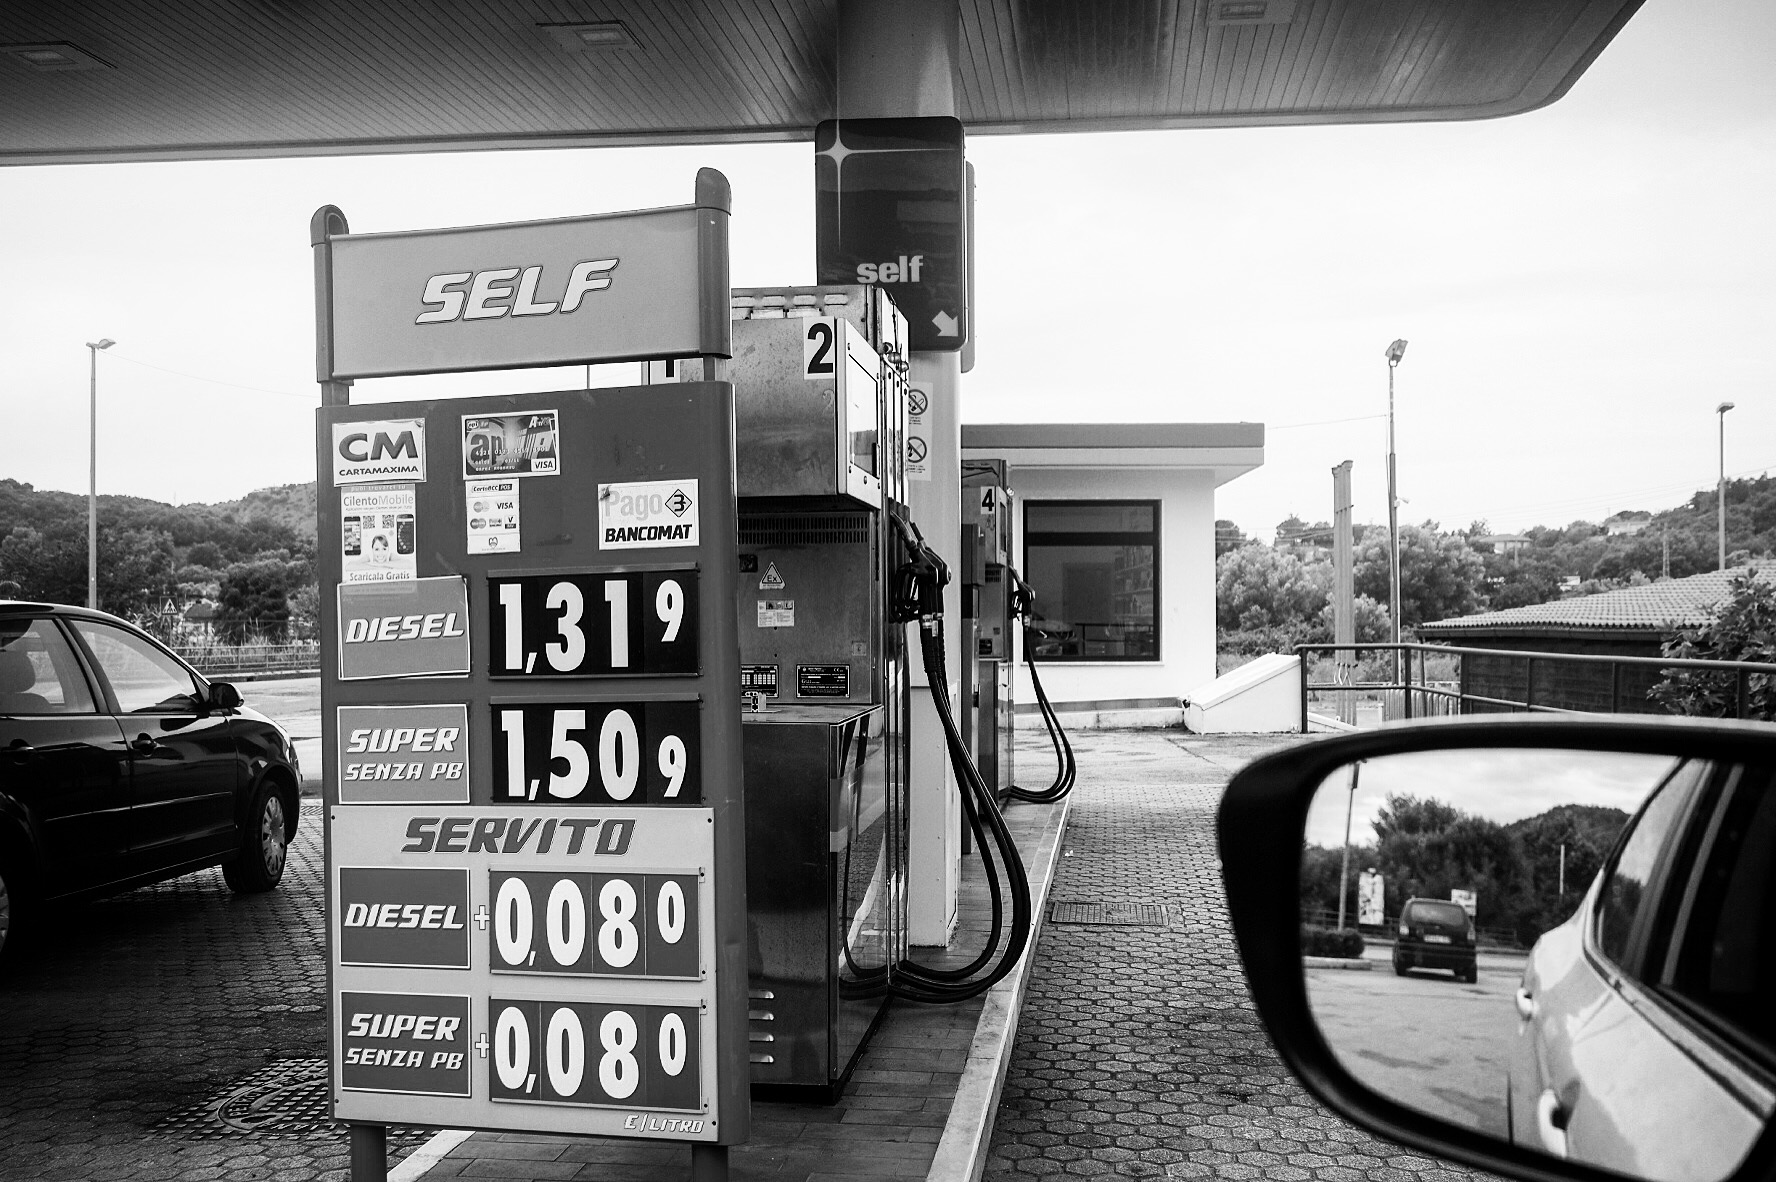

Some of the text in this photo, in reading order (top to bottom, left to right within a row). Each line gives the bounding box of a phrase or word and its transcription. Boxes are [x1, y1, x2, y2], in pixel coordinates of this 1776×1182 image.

[857, 255, 923, 283] self
[415, 258, 619, 325] SELF
[807, 323, 833, 374] 2
[339, 431, 418, 462] CM
[339, 466, 418, 476] CARTAMAXIMA
[535, 461, 553, 469] VISA
[344, 494, 414, 507] CilentoMobile
[604, 490, 663, 521] Pago
[982, 489, 994, 511] 4
[605, 524, 692, 542] BANCOMAT
[350, 571, 410, 582] Scaricala Gratis
[767, 574, 778, 582] Ex
[345, 612, 464, 644] DIESEL
[346, 727, 460, 753] SUPER
[344, 762, 464, 781] SENZA PB
[400, 816, 636, 856] SERVITO
[344, 903, 464, 930] DIESEL
[347, 1013, 461, 1041] SUPER
[345, 1047, 464, 1070] SENZA PB
